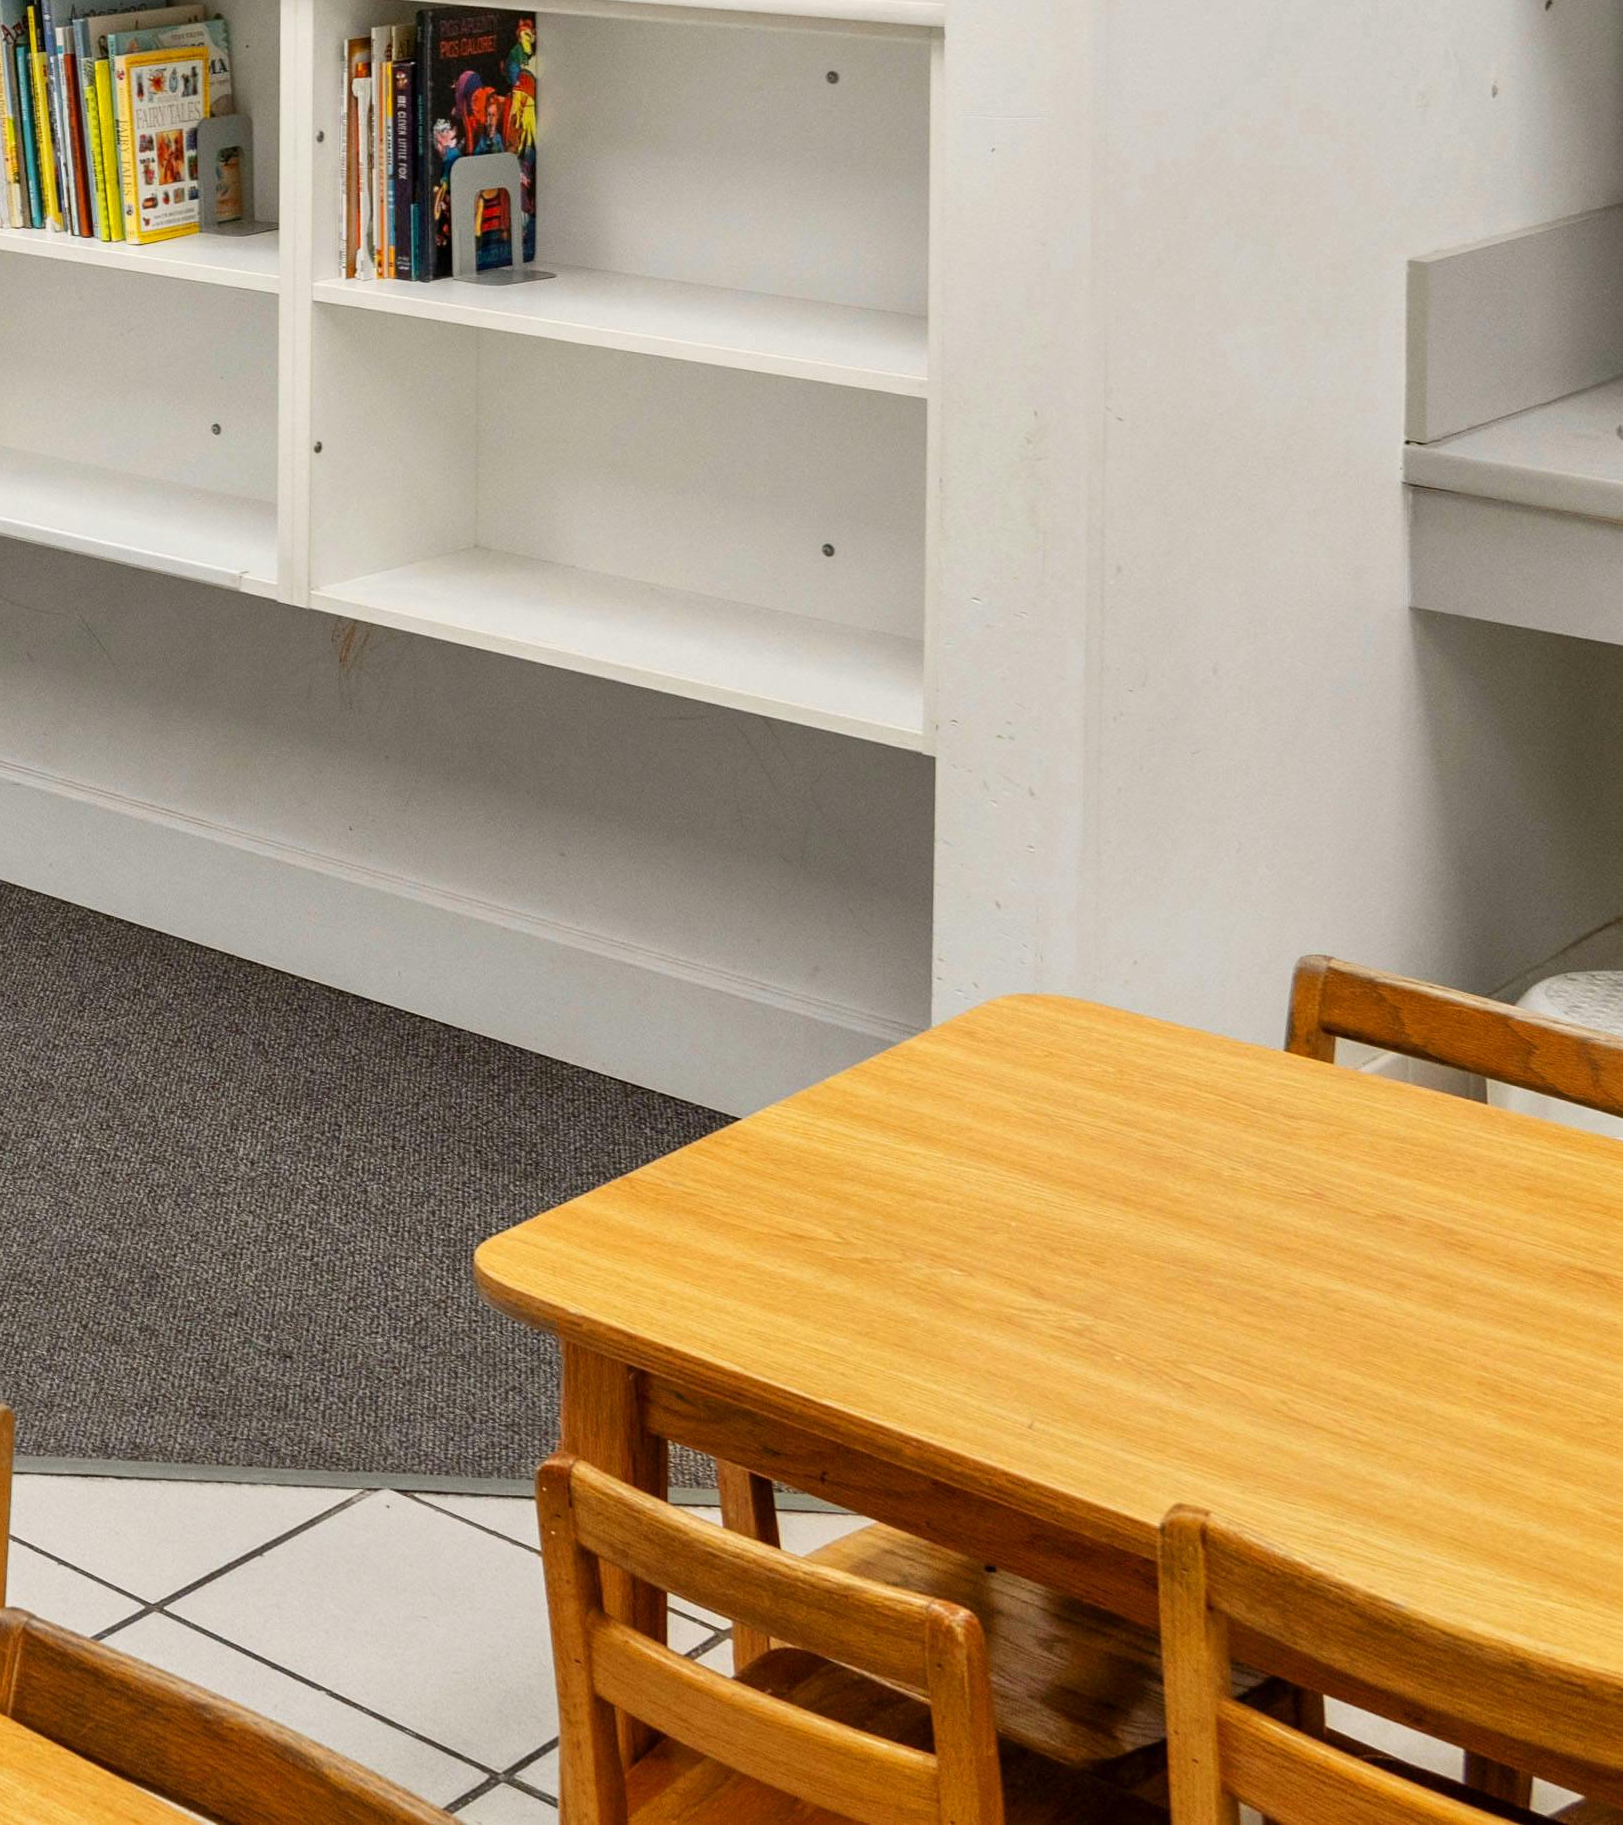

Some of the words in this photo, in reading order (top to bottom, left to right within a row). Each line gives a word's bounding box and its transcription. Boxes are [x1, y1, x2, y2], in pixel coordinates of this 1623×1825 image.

[439, 39, 461, 59] PIGS
[168, 100, 203, 125] TALES
[398, 111, 407, 135] CLEVER
[117, 120, 130, 153] FAIRY
[398, 138, 407, 159] LITTLE
[122, 160, 133, 196] TALES
[398, 162, 407, 180] FOX
